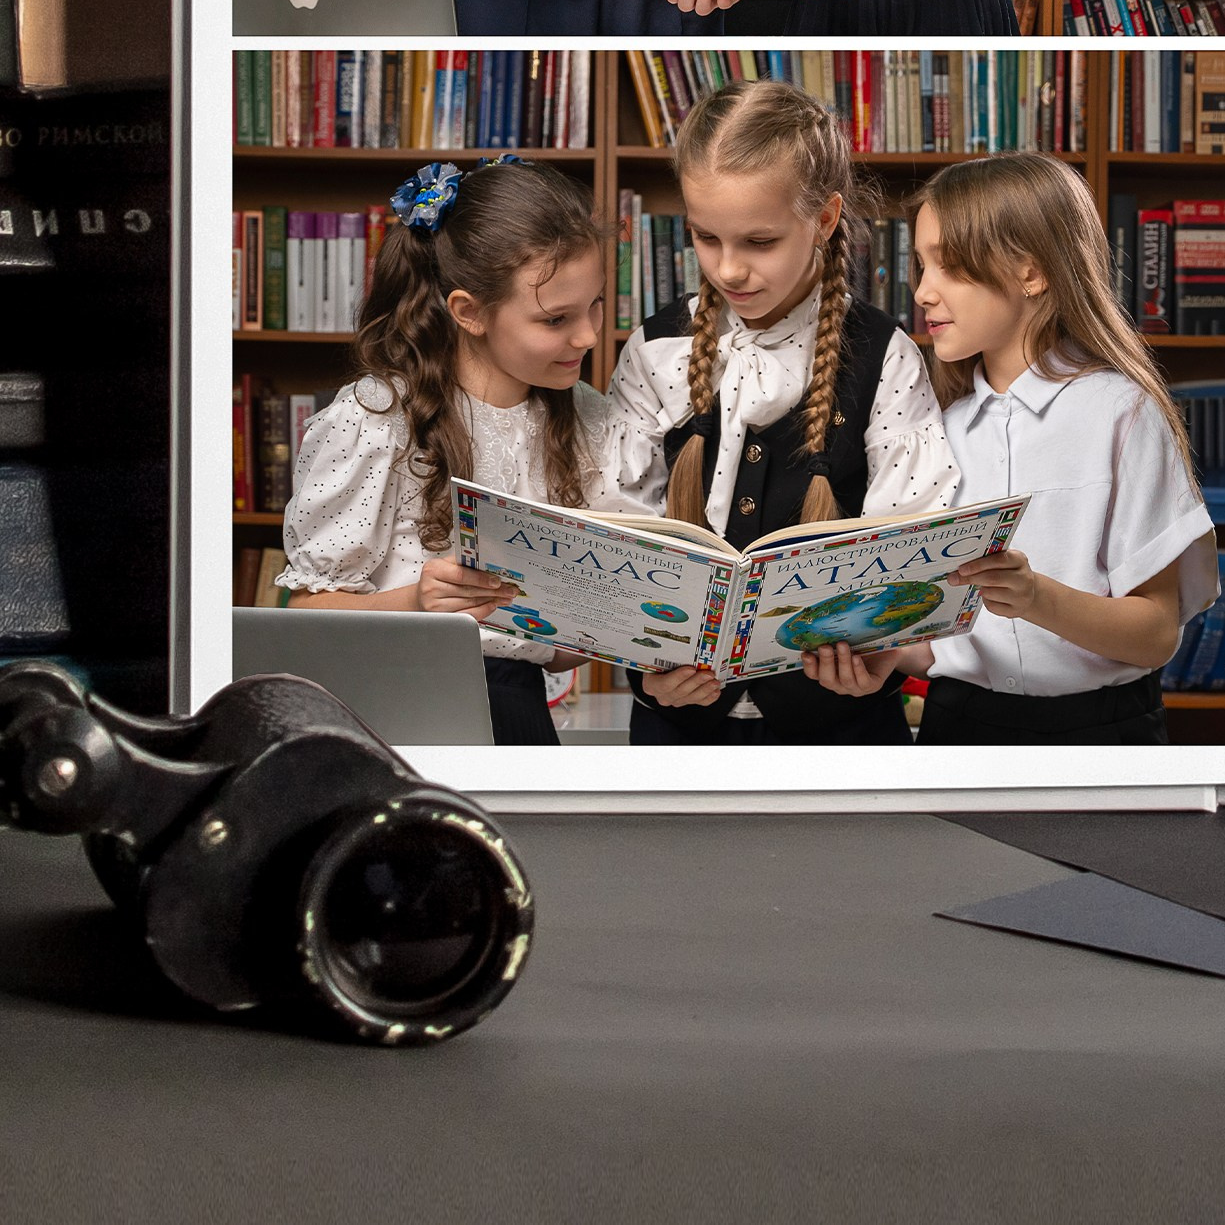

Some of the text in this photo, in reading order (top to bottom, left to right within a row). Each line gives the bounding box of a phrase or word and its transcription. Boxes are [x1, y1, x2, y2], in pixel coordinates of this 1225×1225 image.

[1142, 222, 1160, 290] СТАЛИН
[503, 515, 684, 572] ИЛЛЮСТРИРОВАННЫЙ
[504, 529, 682, 590] АТЛАС
[771, 535, 983, 596] АТЛАС
[777, 521, 989, 574] ИЛЛЮСТРИРОВАННЫЙ
[562, 563, 621, 585] МИРА
[836, 573, 905, 593] МИРА
